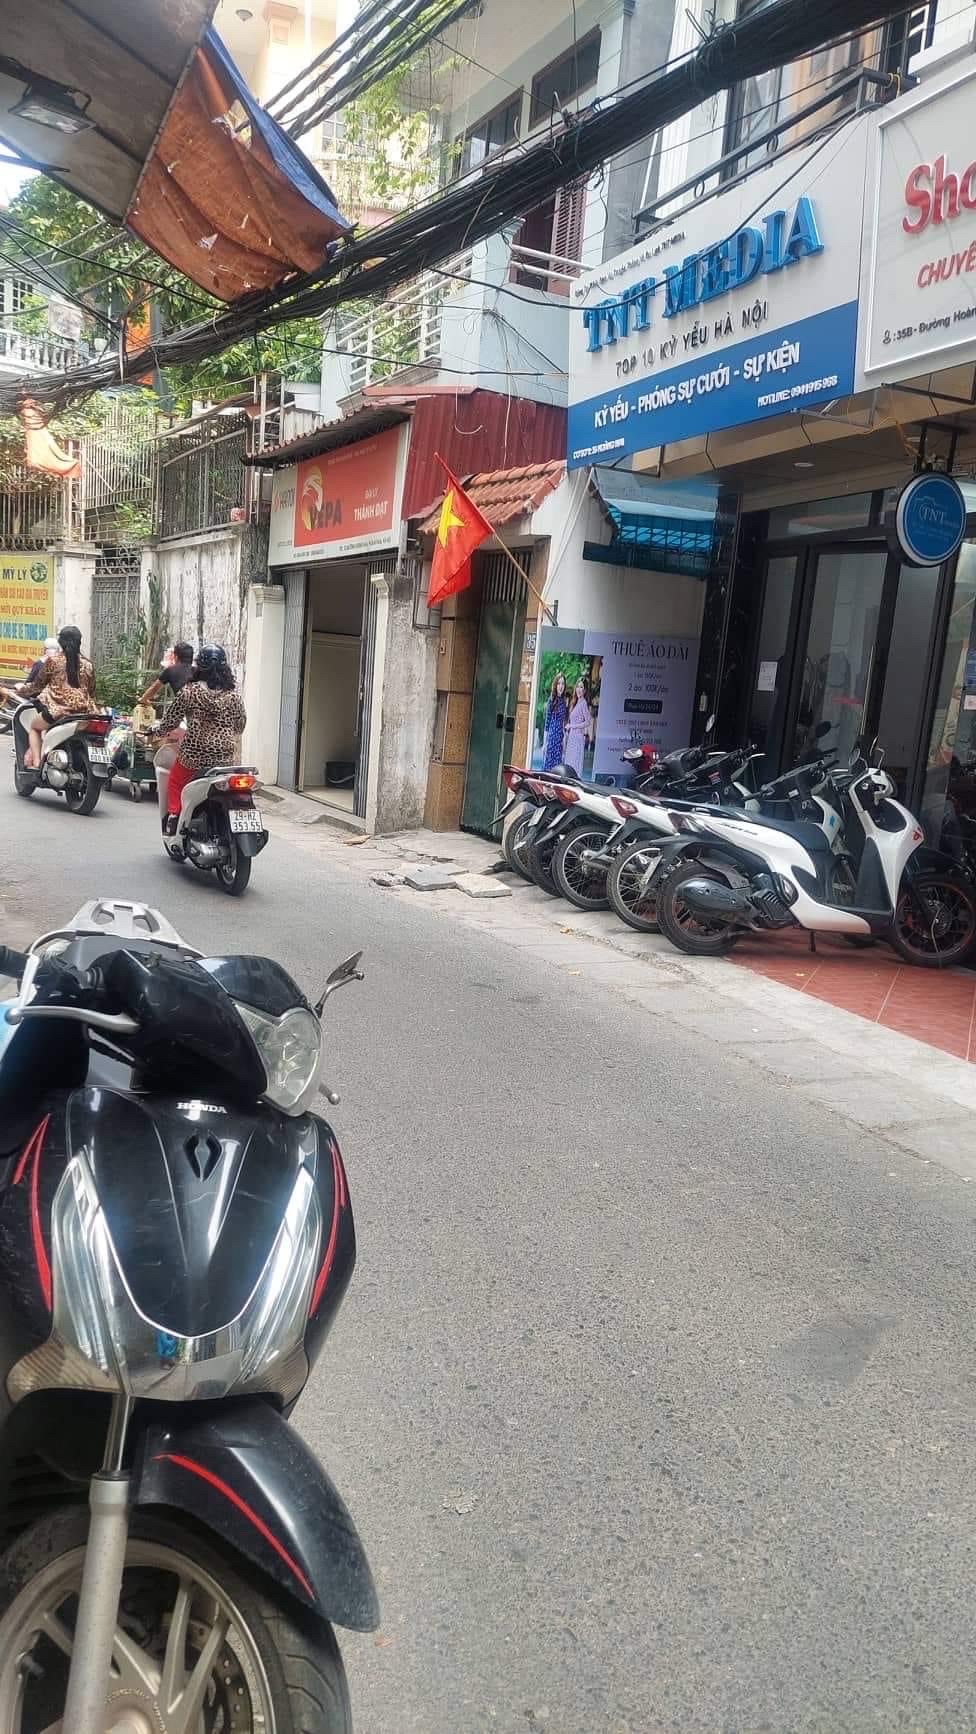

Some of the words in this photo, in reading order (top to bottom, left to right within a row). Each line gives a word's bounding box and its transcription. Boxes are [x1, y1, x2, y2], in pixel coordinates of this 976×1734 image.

[583, 276, 656, 352] TNT
[662, 194, 824, 319] MEDIA
[616, 354, 636, 378] TOP
[642, 348, 654, 366] 10
[714, 312, 733, 339] HÀ
[742, 299, 768, 330] NỘI
[919, 317, 951, 333] Đường
[611, 394, 628, 423] YẾU
[638, 384, 676, 414] PHÓNG
[678, 377, 696, 405] SỰ
[697, 363, 730, 394] CƯỚI
[744, 353, 766, 386] SỰ
[766, 341, 800, 376] KIỆN
[612, 640, 644, 657] THUÊ
[646, 640, 666, 658] ÁO
[176, 1102, 228, 1114] HONDA
